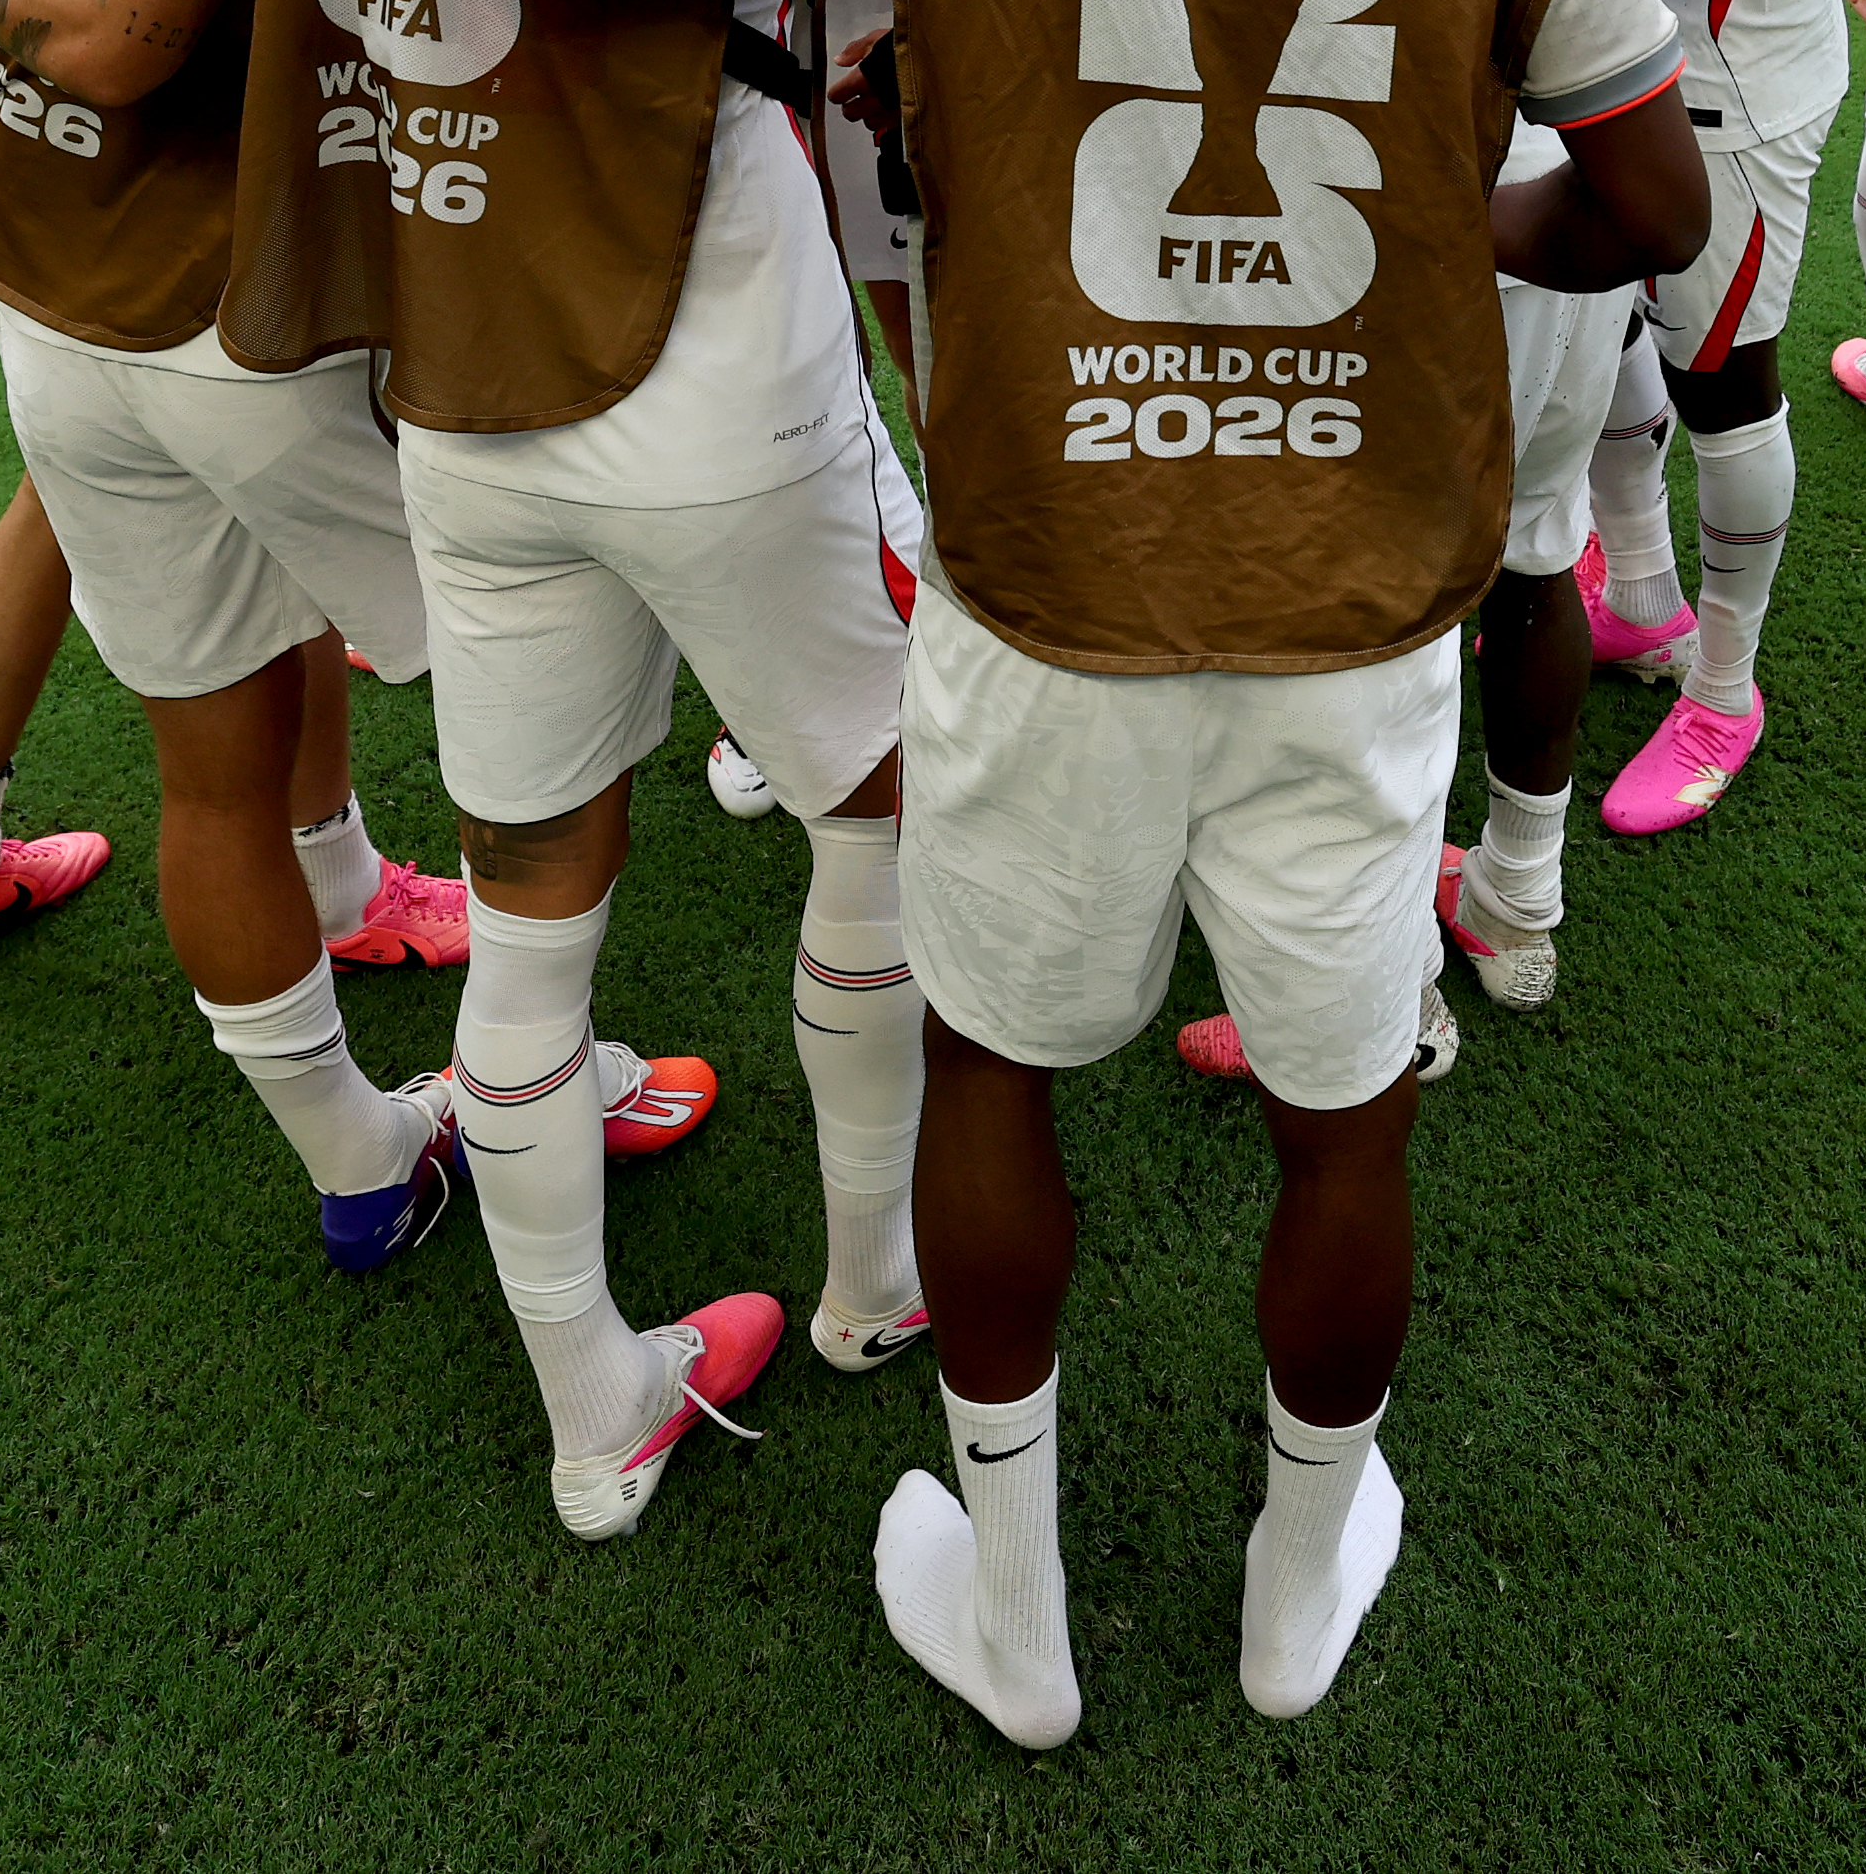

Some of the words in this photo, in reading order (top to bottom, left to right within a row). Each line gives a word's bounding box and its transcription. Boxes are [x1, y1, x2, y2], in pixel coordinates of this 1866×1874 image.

[406, 106, 499, 151] CUP
[1158, 235, 1292, 284] FIFA
[1066, 344, 1254, 386] WORLD
[1264, 347, 1369, 387] CUP
[773, 412, 830, 443] AERO-FIT
[1063, 393, 1363, 462] 2026
